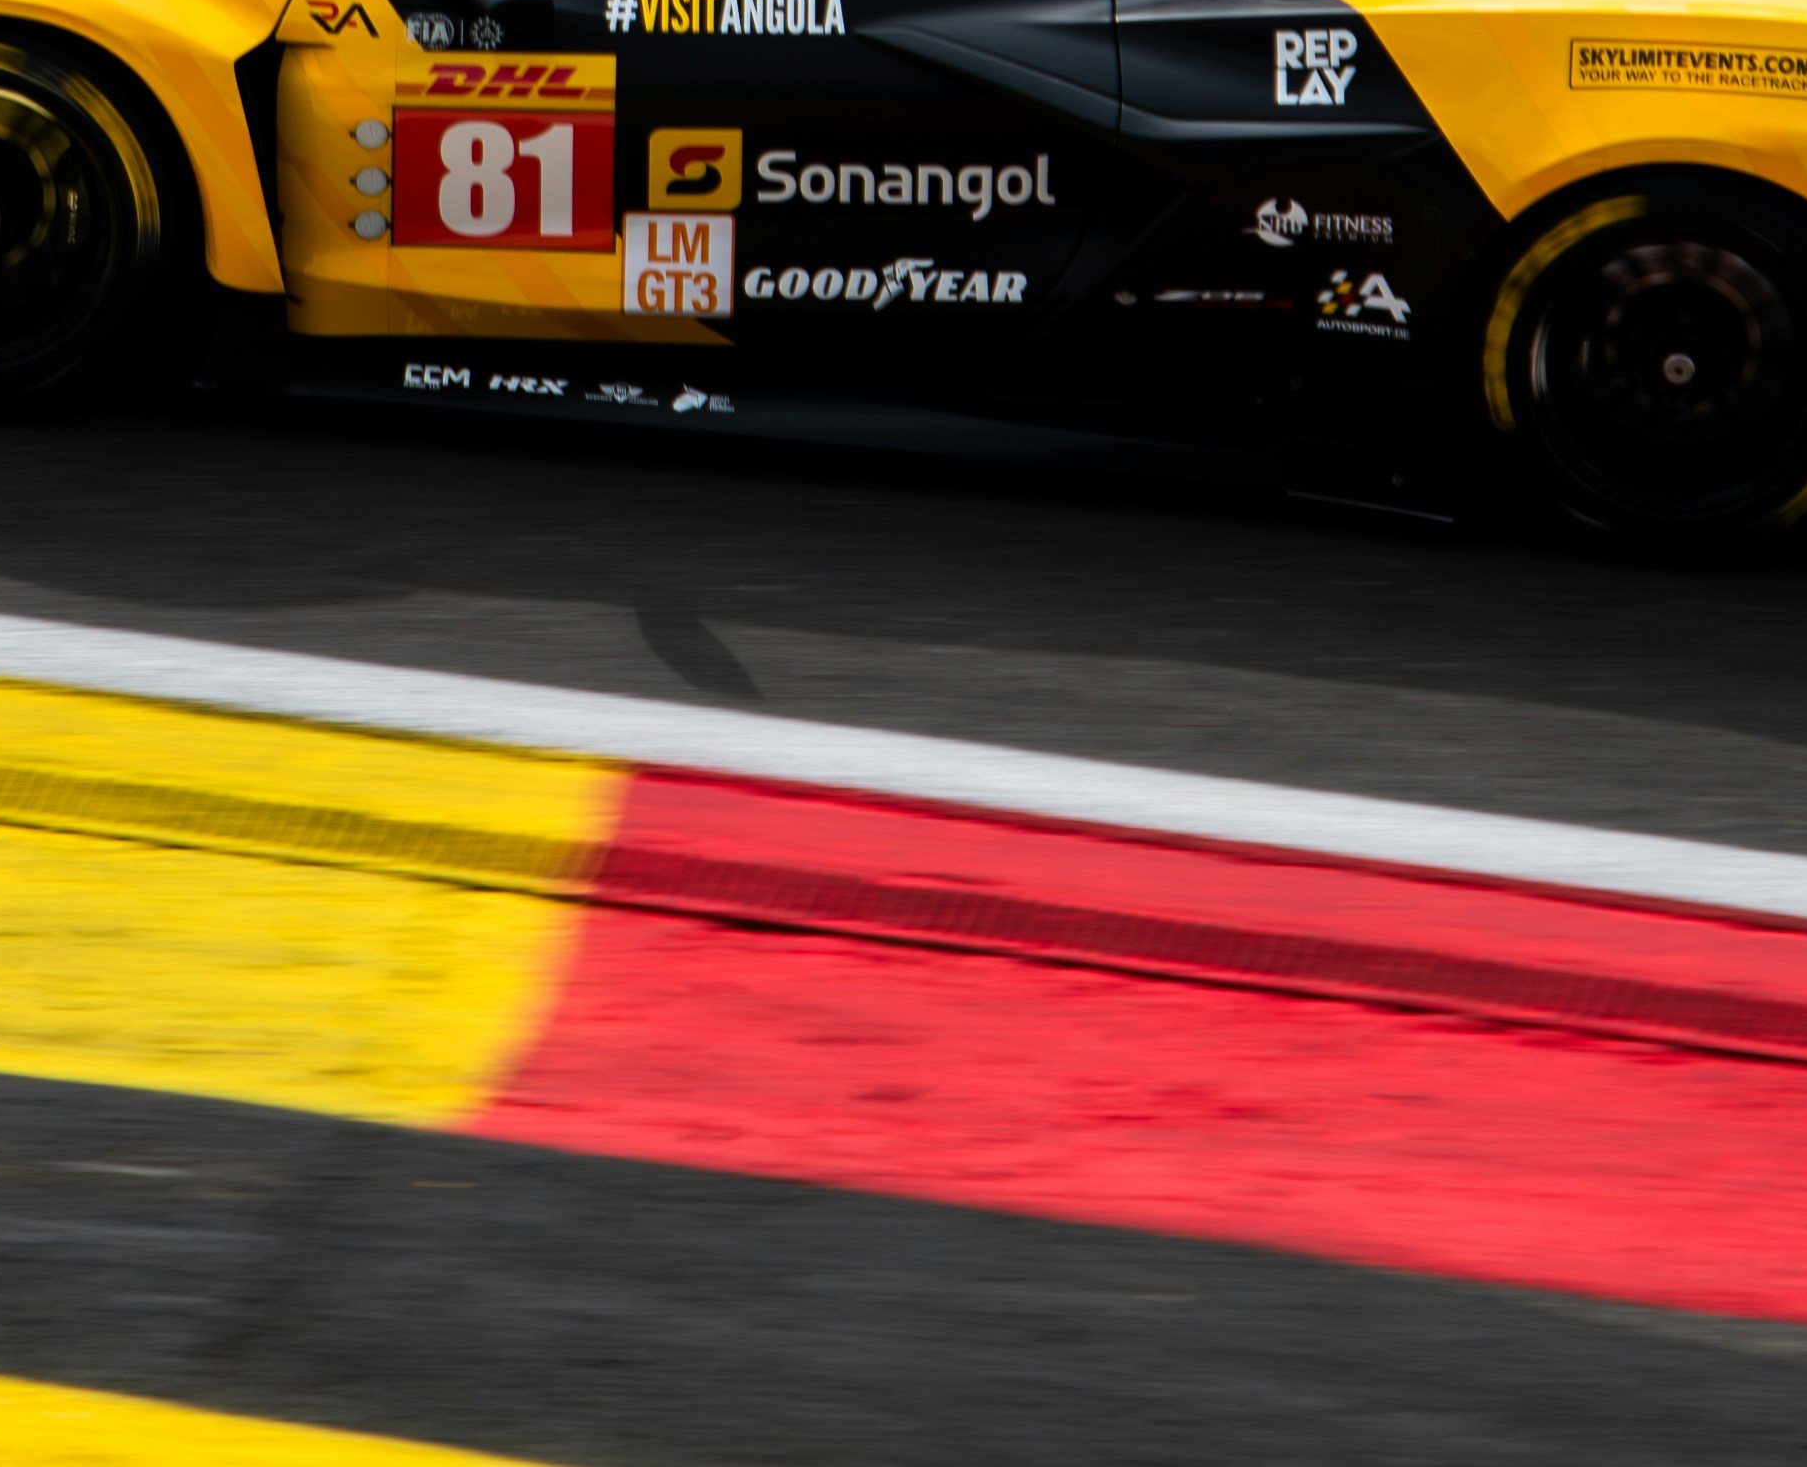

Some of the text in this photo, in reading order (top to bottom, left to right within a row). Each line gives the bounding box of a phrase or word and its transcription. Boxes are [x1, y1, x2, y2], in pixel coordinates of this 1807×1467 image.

[405, 17, 451, 43] FIA
[1275, 29, 1358, 69] REP
[425, 64, 586, 99] DHL
[1276, 67, 1356, 105] LAY
[1580, 68, 1622, 82] YOUR
[1626, 69, 1657, 83] WAY
[1662, 70, 1682, 84] TO
[1687, 72, 1715, 86] THE
[438, 120, 575, 239] 81
[756, 152, 1057, 221] Sonangol
[1314, 213, 1393, 234] FITNESS
[647, 222, 711, 267] LM
[636, 269, 719, 314] GT3
[743, 257, 1029, 311] GOODYEAR
[404, 363, 471, 389] CCM
